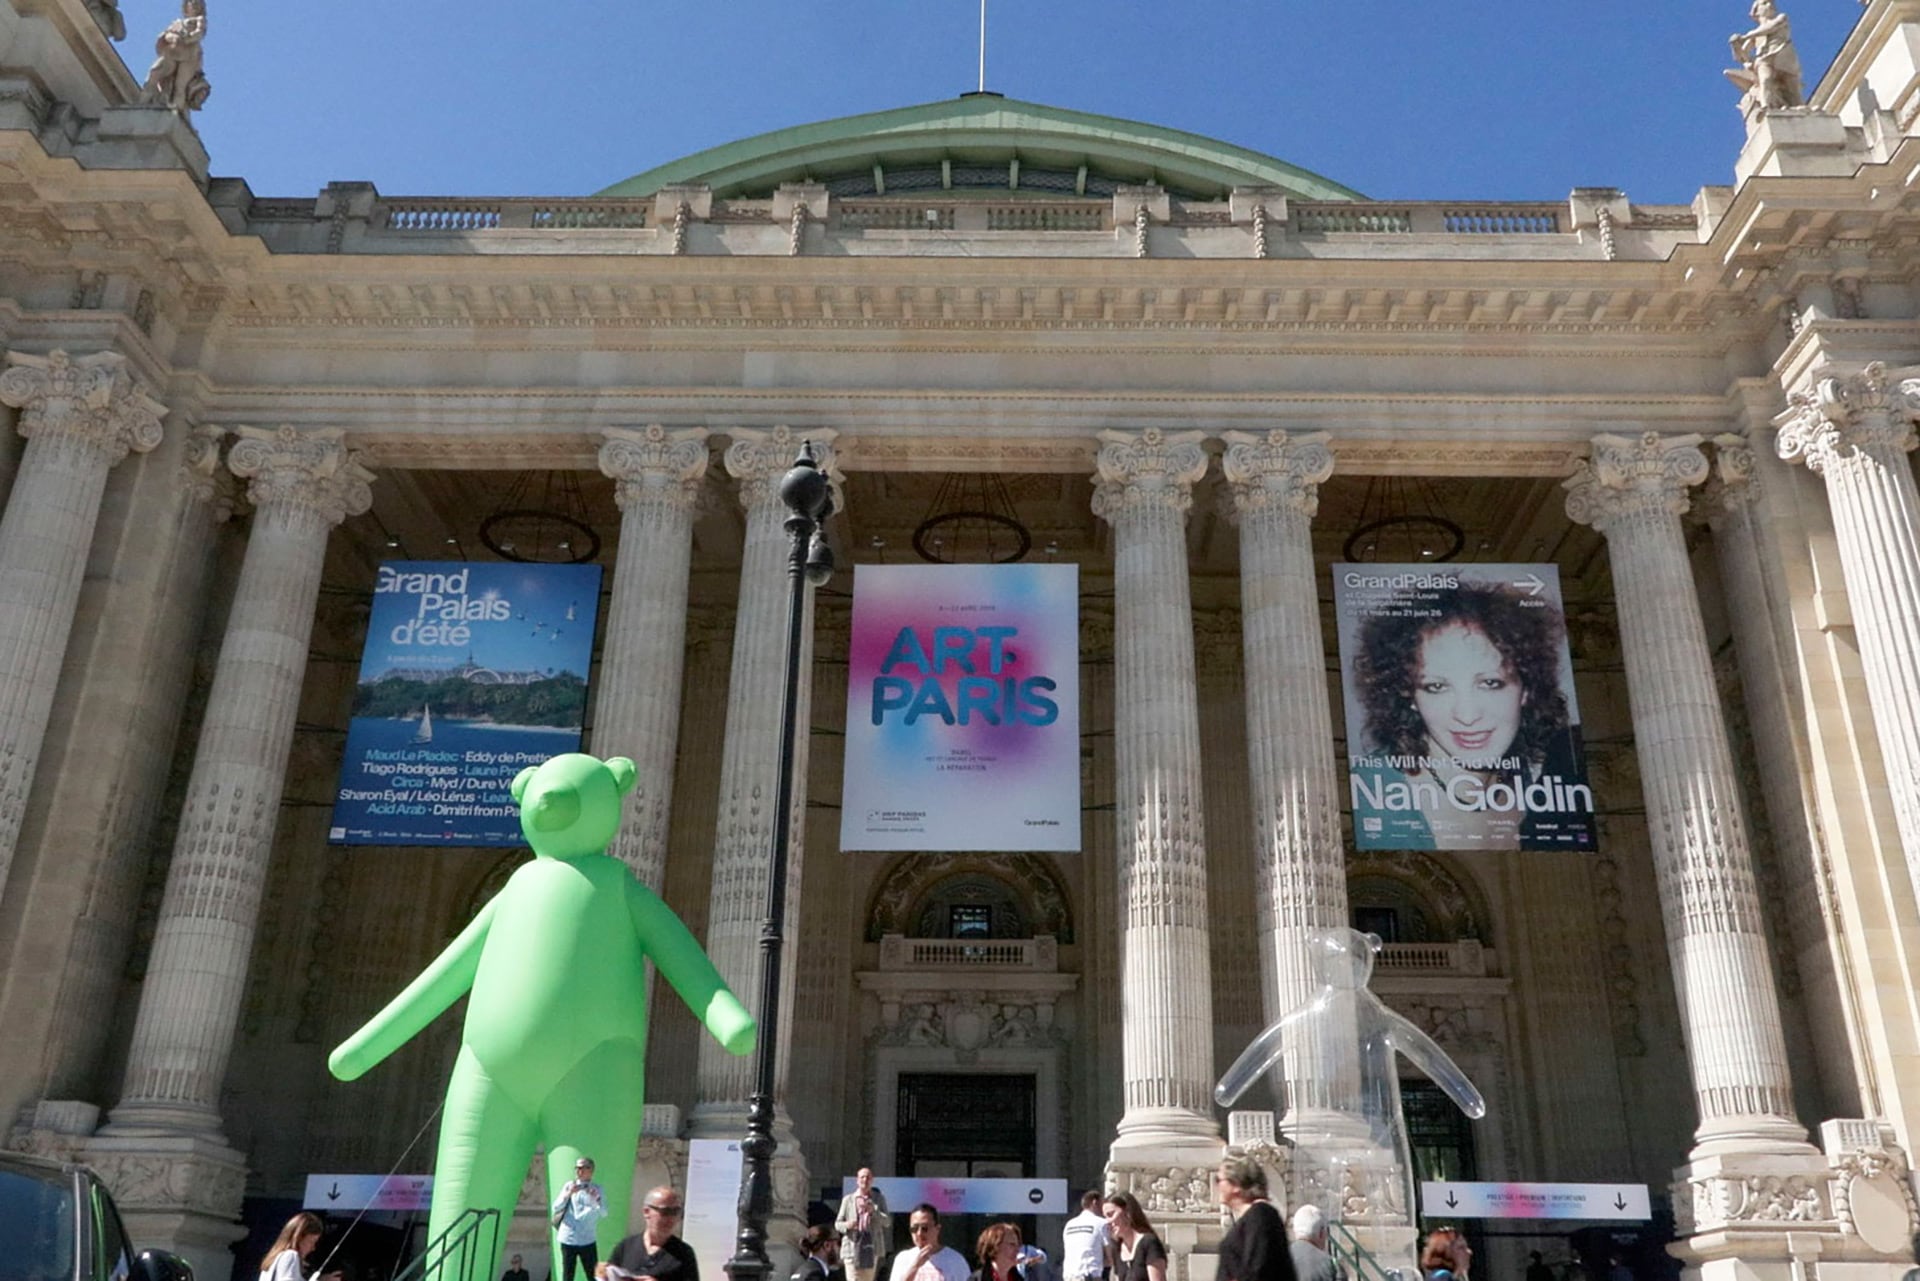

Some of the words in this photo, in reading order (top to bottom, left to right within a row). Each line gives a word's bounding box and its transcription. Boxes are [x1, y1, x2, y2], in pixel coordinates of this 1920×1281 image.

[375, 566, 469, 594] Grand
[1344, 572, 1459, 589] GrandPalais
[418, 593, 511, 620] Palais
[1414, 609, 1429, 617] juin
[391, 618, 471, 646] d'été
[880, 626, 1018, 674] ART
[872, 676, 1058, 726] PARIS
[365, 749, 400, 760] Maud
[402, 750, 416, 760] Le
[417, 750, 459, 762] Pladec
[465, 751, 497, 764] Eddy
[498, 752, 514, 763] de
[1351, 755, 1382, 768] This
[1385, 755, 1415, 769] Will
[1418, 755, 1446, 769] Not
[1452, 756, 1482, 769] End
[1485, 757, 1520, 770] Well
[362, 762, 396, 776] Tiago
[396, 763, 458, 776] Rodrigues
[465, 764, 498, 775] Laure
[392, 776, 423, 787] Circa
[431, 777, 458, 790] Myd
[467, 779, 496, 789] Dure
[498, 779, 512, 789] Vi
[340, 789, 383, 801] Sharon
[384, 789, 408, 802] Eyal
[417, 790, 440, 801] Léo
[441, 791, 475, 803] Lérus
[1350, 773, 1439, 811] Nan
[1446, 775, 1594, 812] Goldin
[366, 803, 396, 814] Acid
[396, 804, 426, 815] Arab
[433, 804, 472, 815] Dimitri
[473, 805, 503, 816] from
[504, 806, 521, 816] Pa
